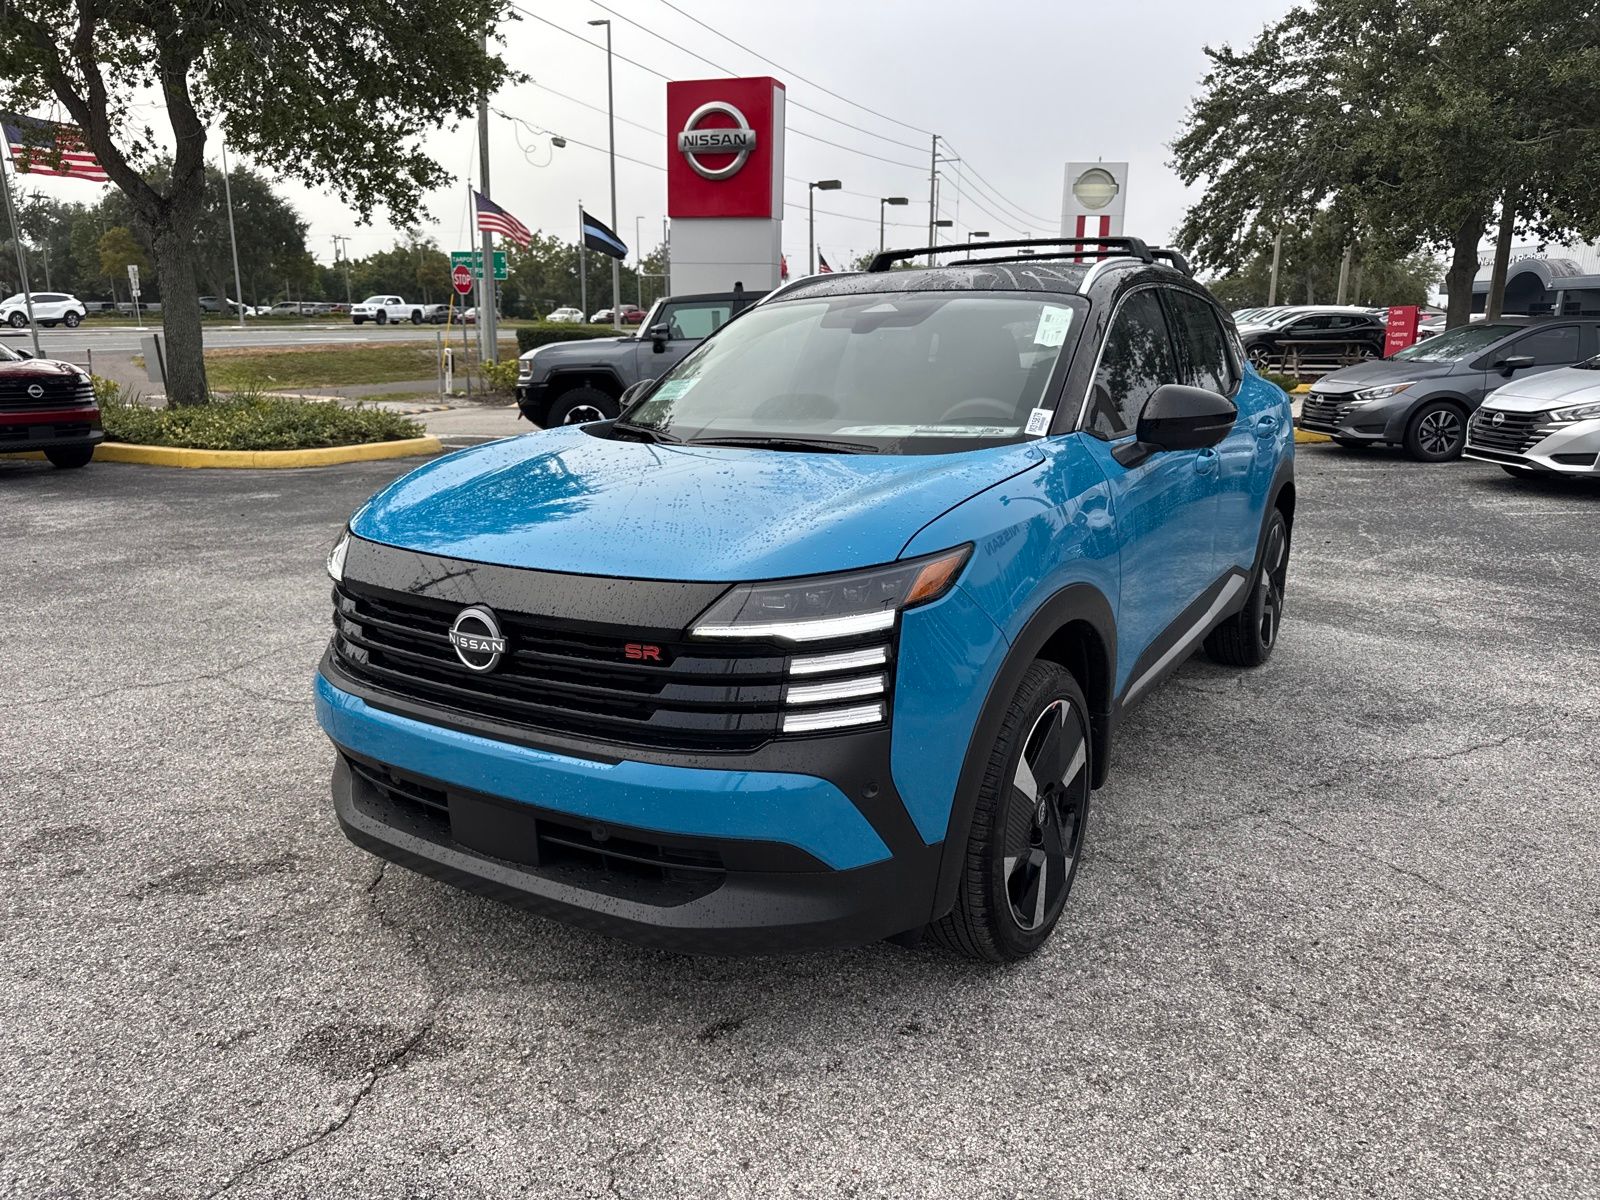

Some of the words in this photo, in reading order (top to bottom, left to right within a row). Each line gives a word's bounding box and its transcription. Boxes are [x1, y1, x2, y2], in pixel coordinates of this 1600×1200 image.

[683, 133, 747, 147] NISSAN
[454, 274, 471, 285] STOP
[1390, 339, 1403, 347] Parking
[449, 632, 503, 652] NISSAN
[624, 643, 662, 661] SR
